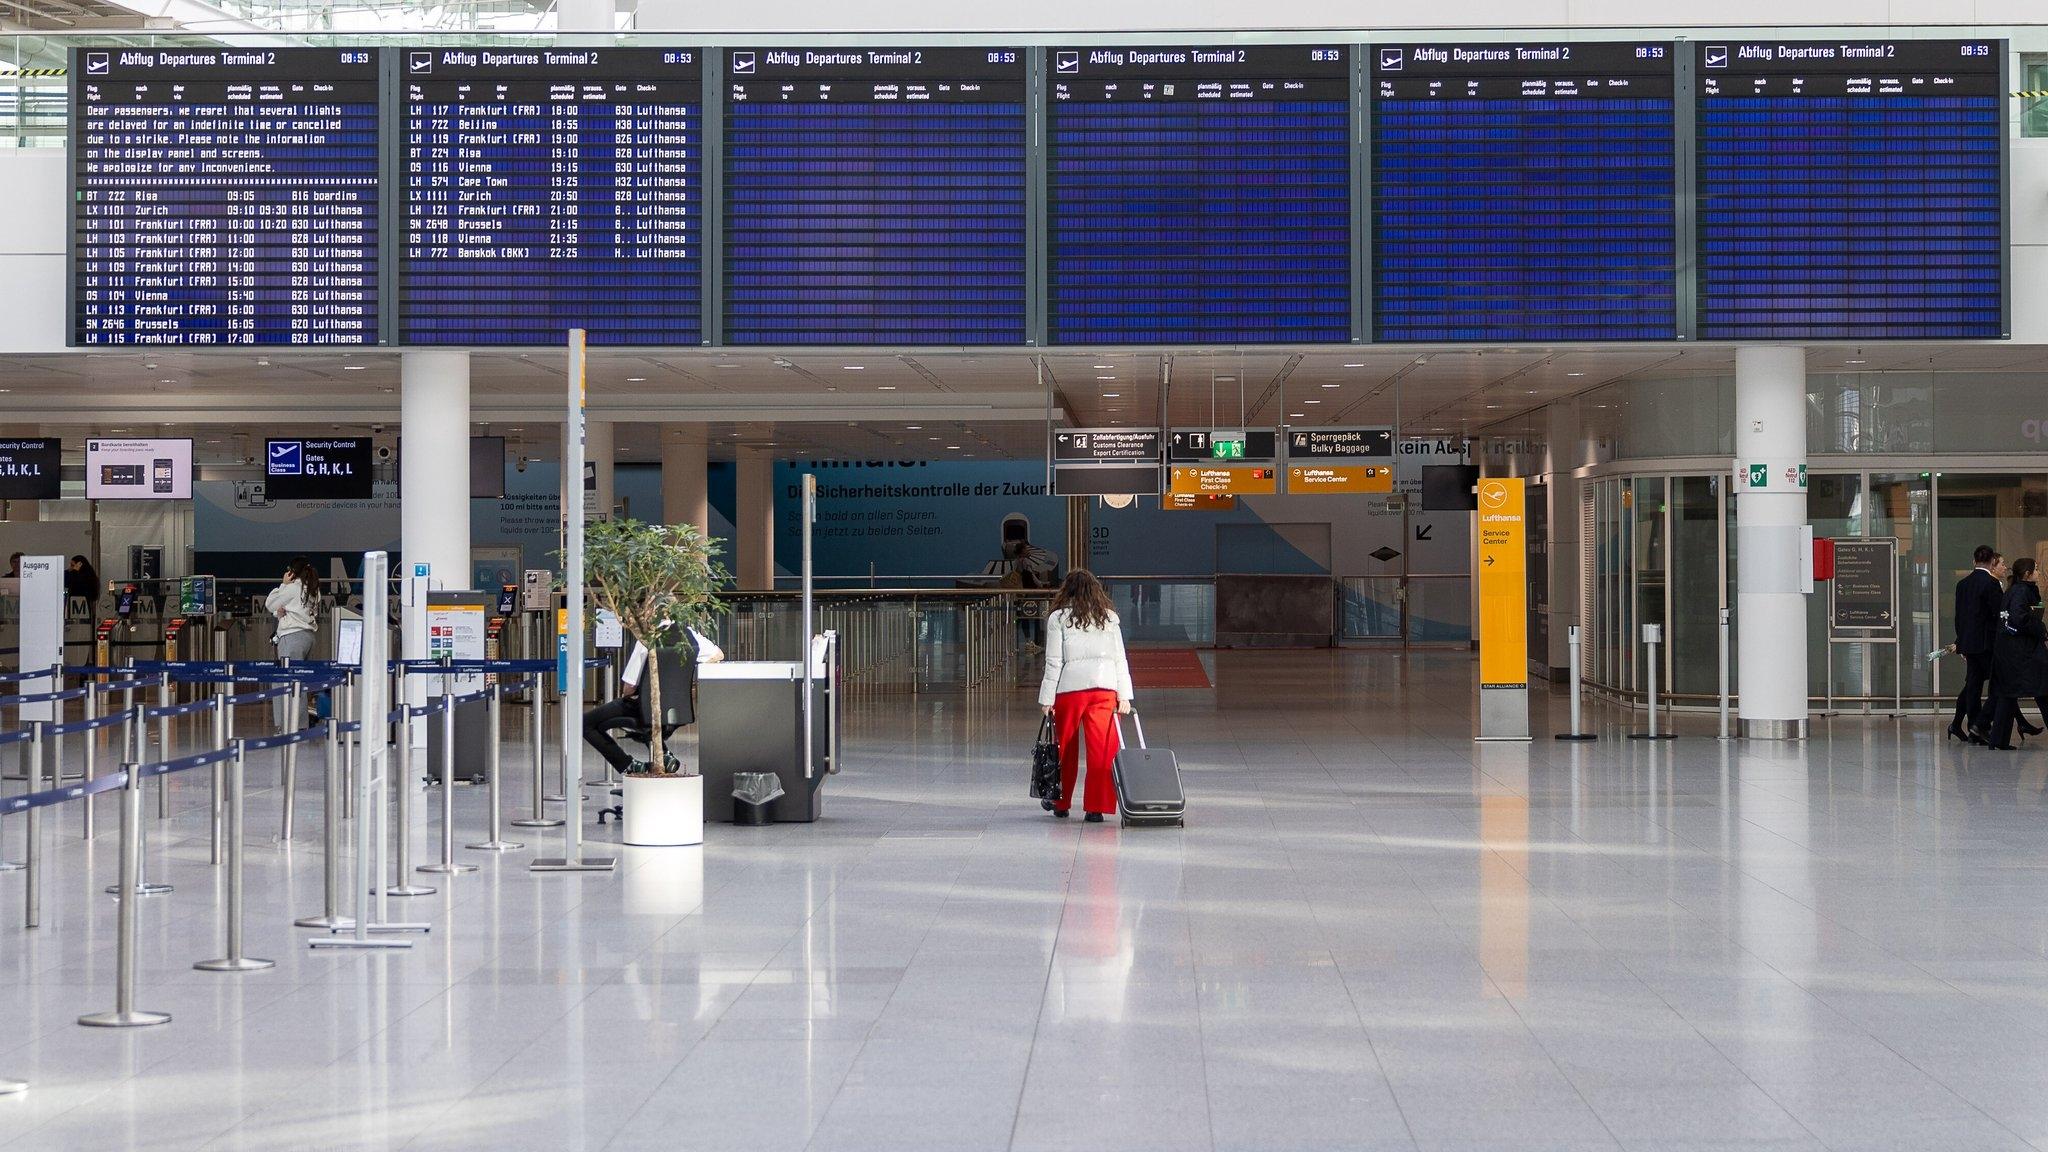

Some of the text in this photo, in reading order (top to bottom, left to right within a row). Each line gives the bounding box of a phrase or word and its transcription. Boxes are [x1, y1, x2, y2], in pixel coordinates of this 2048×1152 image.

[1312, 50, 1338, 60] 08:53
[1414, 47, 1569, 63] Abflug Departures Terminal 2
[1636, 48, 1663, 57] 08:53
[1738, 45, 1894, 60] Abflug Departures Terminal 2
[1961, 46, 1988, 55] 08:53
[120, 52, 275, 67] Abflug Departures Terminal 2
[341, 53, 368, 63] 08:53
[443, 52, 598, 67] Abflug Departures Terminal 2
[664, 53, 691, 63] 08:53
[766, 52, 921, 66] Abflug Departures Terminal 2
[988, 53, 1015, 62] 08:53
[1090, 51, 1245, 65] Abflug Departures Terminal 2
[1705, 78, 1717, 87] Flug
[1705, 87, 1720, 95] Flight
[88, 106, 109, 115] Dear
[196, 106, 226, 115] regret
[234, 106, 253, 115] that
[260, 106, 297, 115] several
[305, 106, 341, 115] flights
[411, 120, 685, 129] LH 722 Beijing 18:55 H38 Lufthansa
[87, 163, 98, 172] We
[103, 163, 152, 172] apologize
[159, 163, 173, 172] for
[202, 163, 274, 172] inconvenience.
[87, 191, 97, 200] BT
[109, 191, 125, 201] 222
[136, 191, 157, 201] Riga
[228, 191, 254, 200] 09:05
[314, 191, 357, 200] boarding
[1311, 432, 1361, 443] Sperrgepäck
[0, 442, 20, 450] ecurity
[305, 441, 332, 450] Security
[1311, 444, 1370, 453] Bulky Baggage
[7, 464, 18, 476] H,
[21, 464, 32, 476] K,
[34, 464, 41, 475] L
[306, 463, 353, 476] G, H, K, L
[788, 482, 1055, 498] Di Sicherheitskontrolle der Zukunf
[296, 501, 330, 509] electronic
[332, 501, 357, 509] devices
[367, 502, 382, 511] your
[825, 511, 848, 521] bald
[867, 510, 893, 521] allen
[896, 509, 937, 522] Spuren.
[500, 526, 523, 535] liquids
[823, 527, 849, 538] jetzt
[867, 526, 903, 536] beiden
[906, 525, 943, 536] Seiten.
[23, 561, 50, 571] Ausgang
